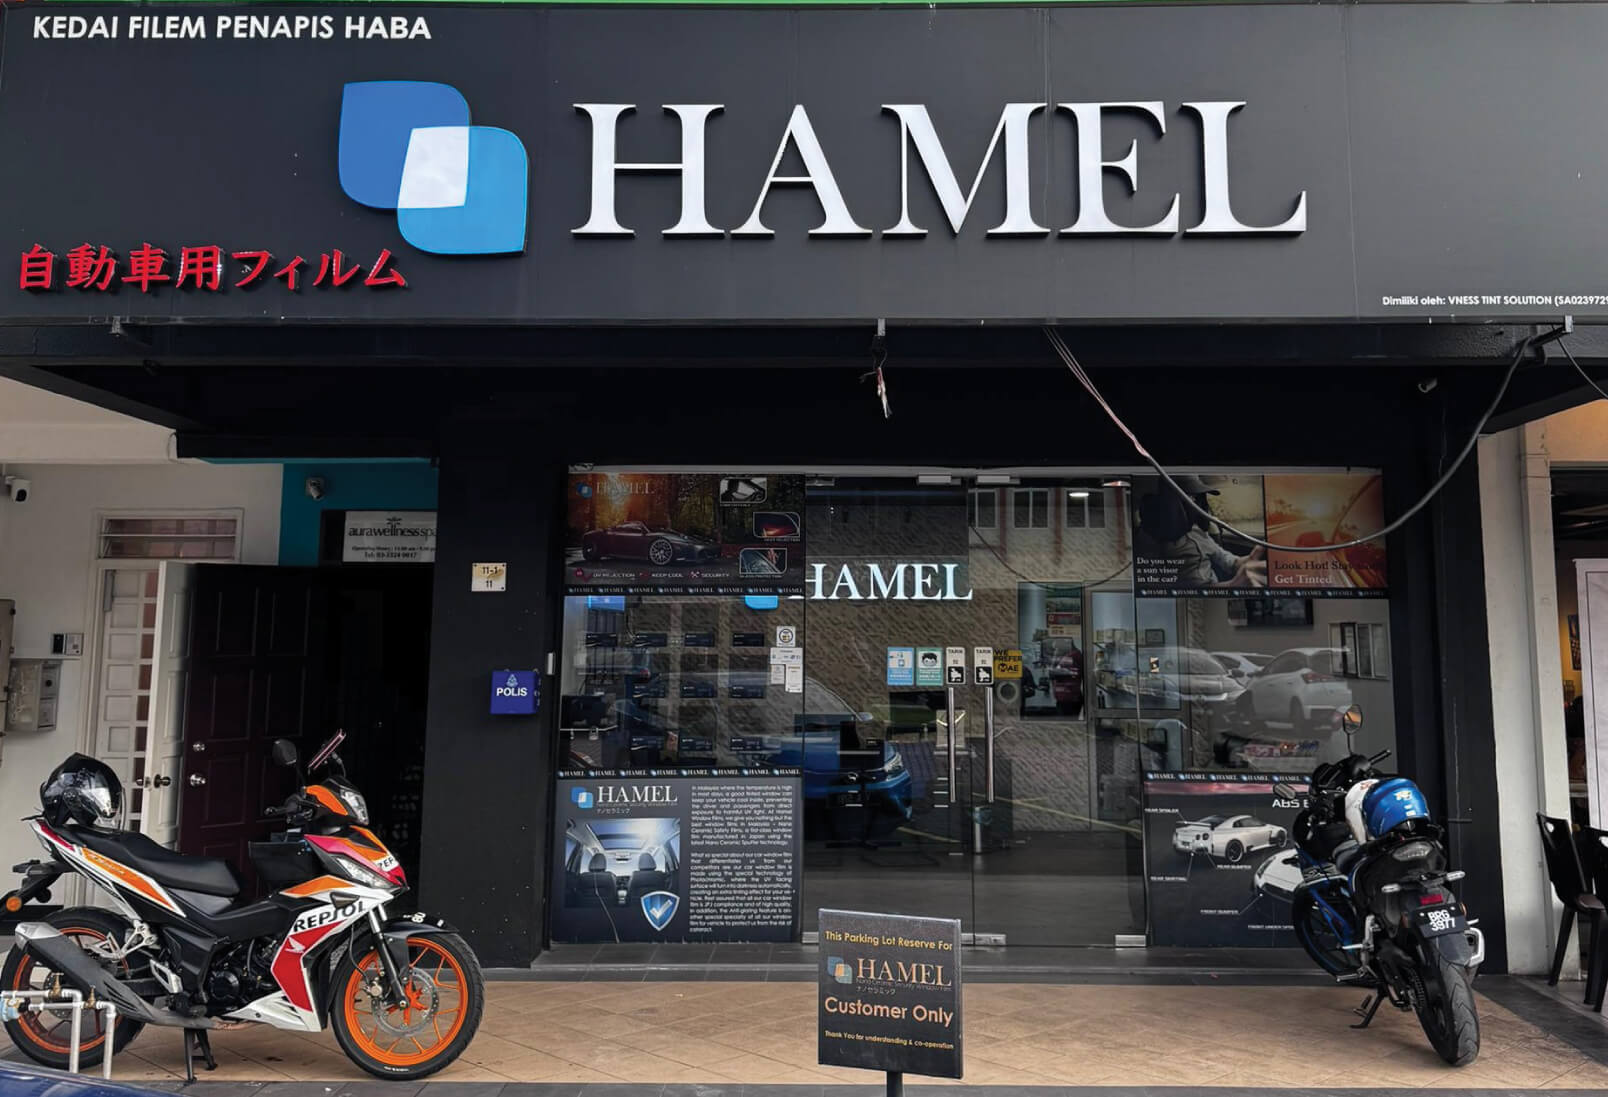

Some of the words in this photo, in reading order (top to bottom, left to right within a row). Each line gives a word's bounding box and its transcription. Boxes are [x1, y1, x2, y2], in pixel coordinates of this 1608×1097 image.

[33, 16, 118, 39] KEDAI
[128, 16, 206, 39] FILEM
[216, 16, 335, 39] PENAPIS
[345, 16, 432, 39] HABA
[571, 101, 1307, 235] HAMEL
[20, 243, 408, 292] 自動車用フィルム
[1382, 296, 1419, 305] Dimiliki
[1420, 296, 1446, 305] oleh:
[1448, 296, 1479, 305] VNESS
[1481, 296, 1501, 305] TINT
[1503, 296, 1551, 305] SOLUTION
[1137, 557, 1148, 565] Do
[1150, 558, 1165, 567] you
[1159, 566, 1178, 574] visor
[1274, 560, 1302, 570] Look
[1305, 560, 1328, 570] Hot!
[788, 563, 973, 600] HAMEL
[1146, 575, 1159, 583] the
[1161, 575, 1178, 583] car?
[1274, 574, 1293, 584] Get
[1296, 574, 1332, 584] Tinted
[496, 687, 528, 697] POLIS
[597, 785, 678, 803] HAMEL
[1272, 799, 1300, 809] ABS
[294, 901, 365, 931] REPSOL
[825, 931, 842, 941] This
[844, 933, 879, 946] Parking
[882, 935, 896, 946] Lot
[899, 937, 936, 950] Reserve
[938, 940, 953, 951] For
[856, 958, 952, 986] HAMEL
[824, 996, 908, 1019] Customer
[912, 1004, 954, 1027] Only
[825, 1030, 842, 1038] Thank
[844, 1032, 855, 1040] You
[865, 1034, 908, 1046] understanding
[909, 1038, 913, 1046] &
[914, 1039, 954, 1050] co-operation
